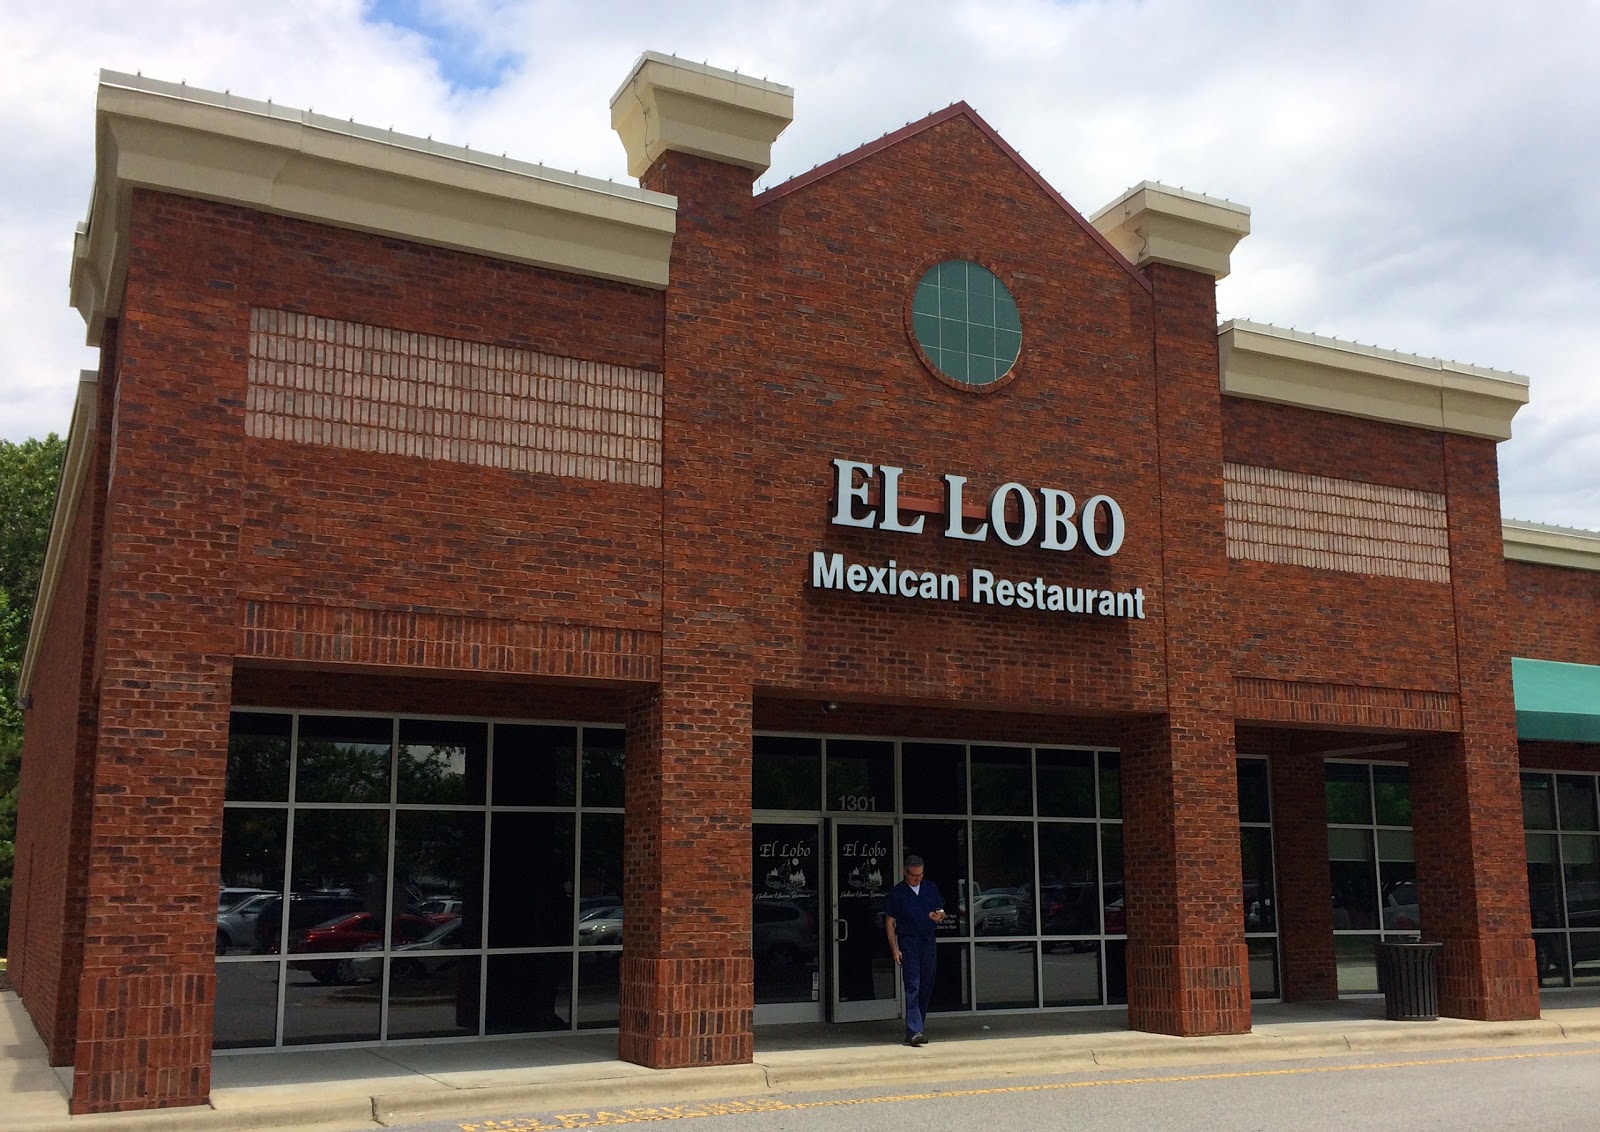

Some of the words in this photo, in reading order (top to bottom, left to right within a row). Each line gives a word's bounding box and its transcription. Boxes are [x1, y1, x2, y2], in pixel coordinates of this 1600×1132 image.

[831, 458, 925, 535] EL
[944, 473, 1125, 557] LOBO
[812, 551, 960, 601] Mexican
[972, 568, 1146, 619] Restaurant
[838, 795, 876, 811] 1301
[760, 841, 778, 857] El
[779, 841, 811, 857] Lobo
[843, 840, 859, 857] El
[860, 841, 887, 857] Lobo
